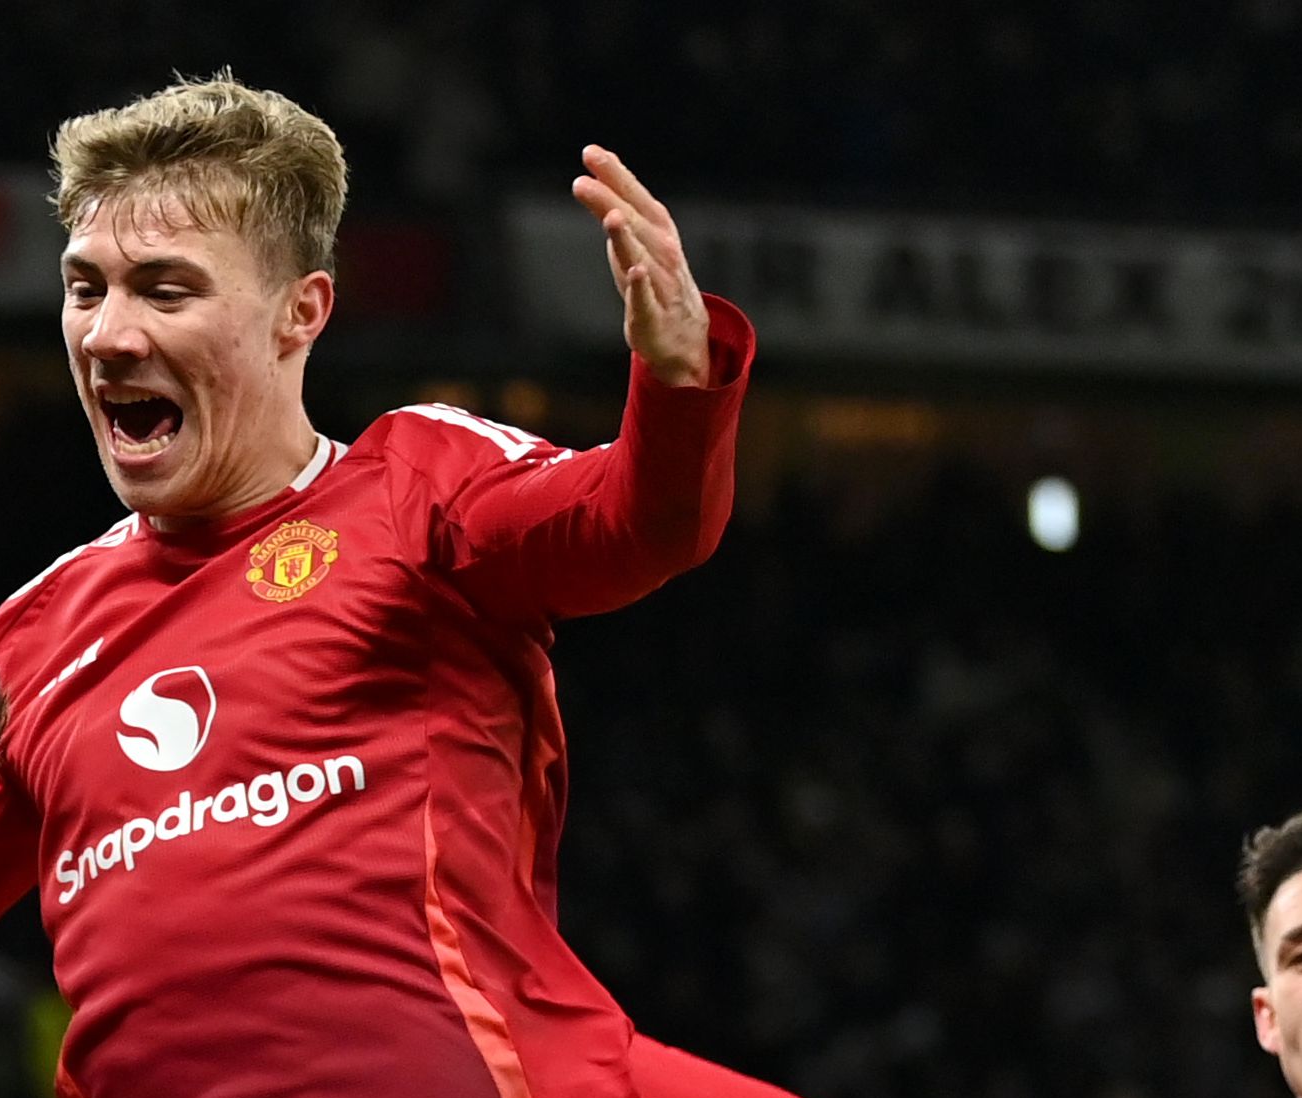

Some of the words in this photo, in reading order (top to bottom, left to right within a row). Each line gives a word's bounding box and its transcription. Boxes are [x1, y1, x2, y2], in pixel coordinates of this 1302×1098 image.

[864, 244, 1171, 336] ALEX
[256, 526, 333, 562] MANCHESTER
[265, 577, 318, 598] UNITED
[55, 755, 366, 904] Snapdragon
